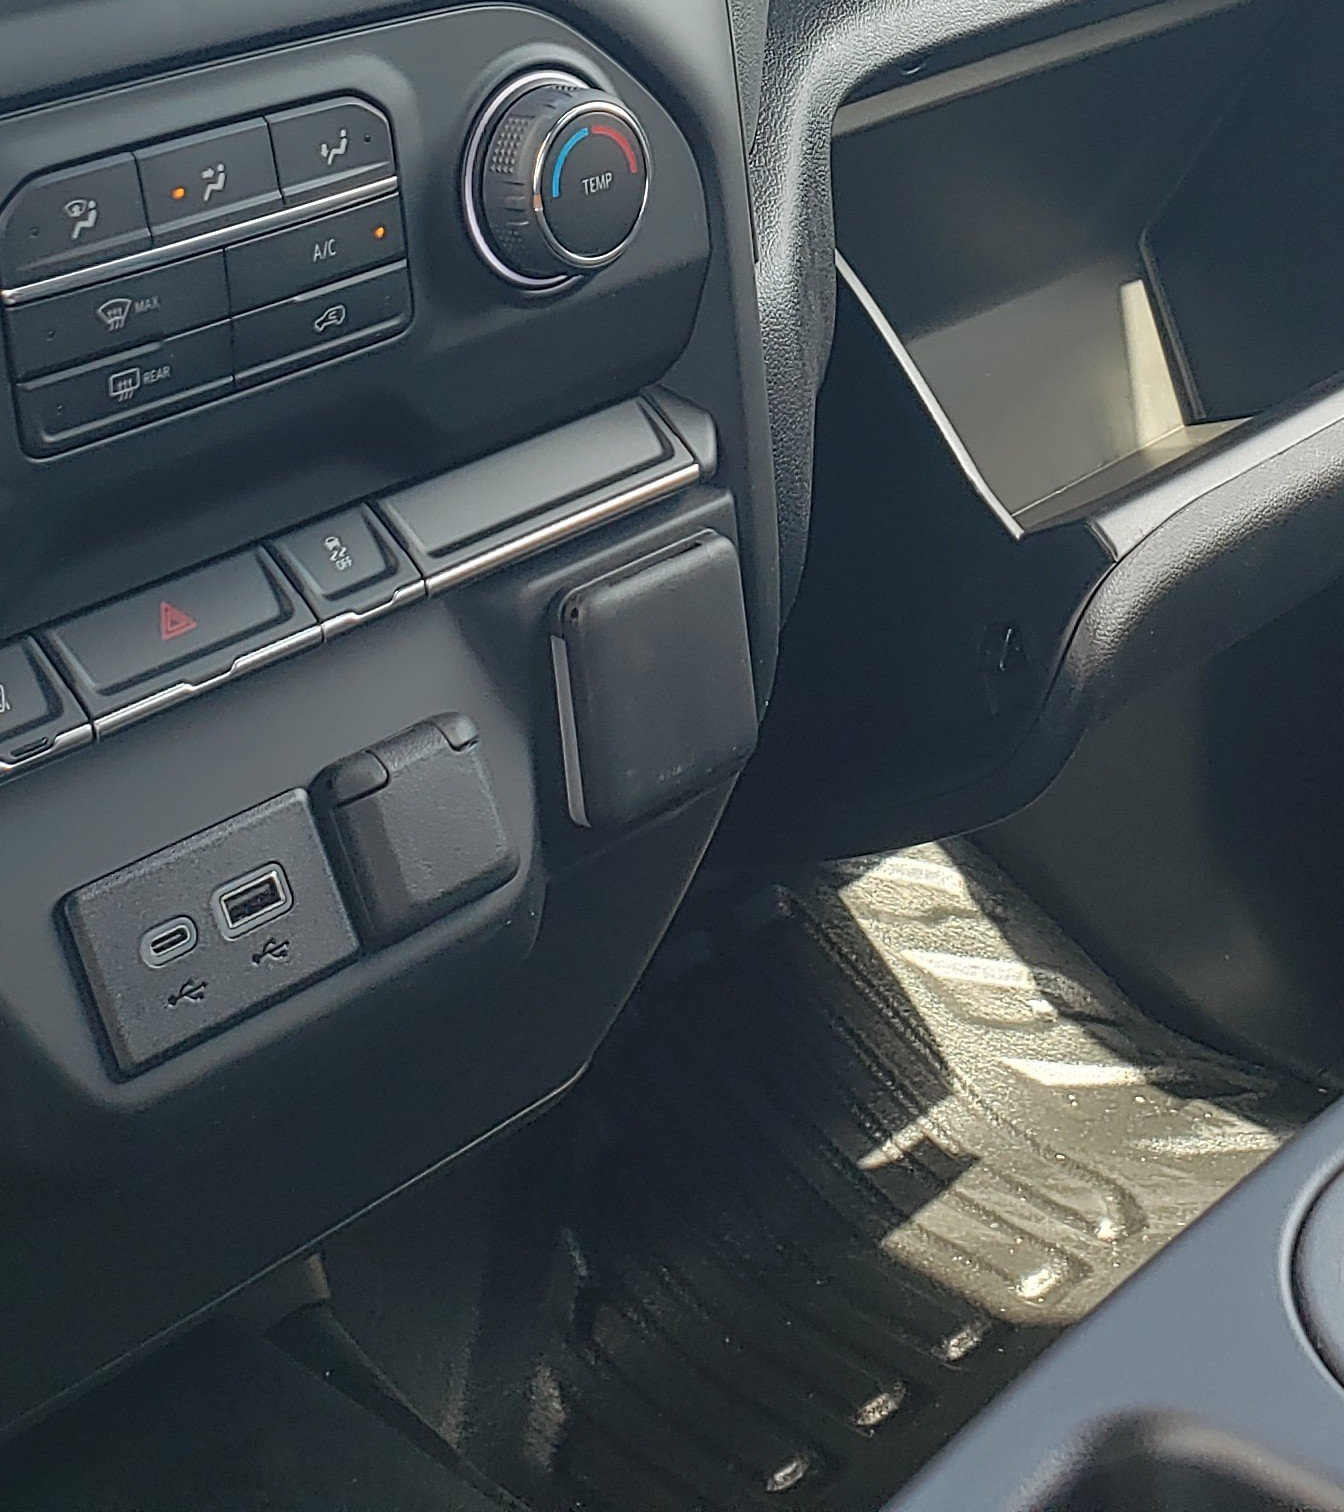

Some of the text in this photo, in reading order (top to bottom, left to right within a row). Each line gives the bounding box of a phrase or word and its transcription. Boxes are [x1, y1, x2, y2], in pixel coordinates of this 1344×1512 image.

[582, 172, 613, 196] TEMP
[313, 238, 336, 262] A/C
[134, 296, 160, 314] MAX
[143, 366, 171, 384] REAR
